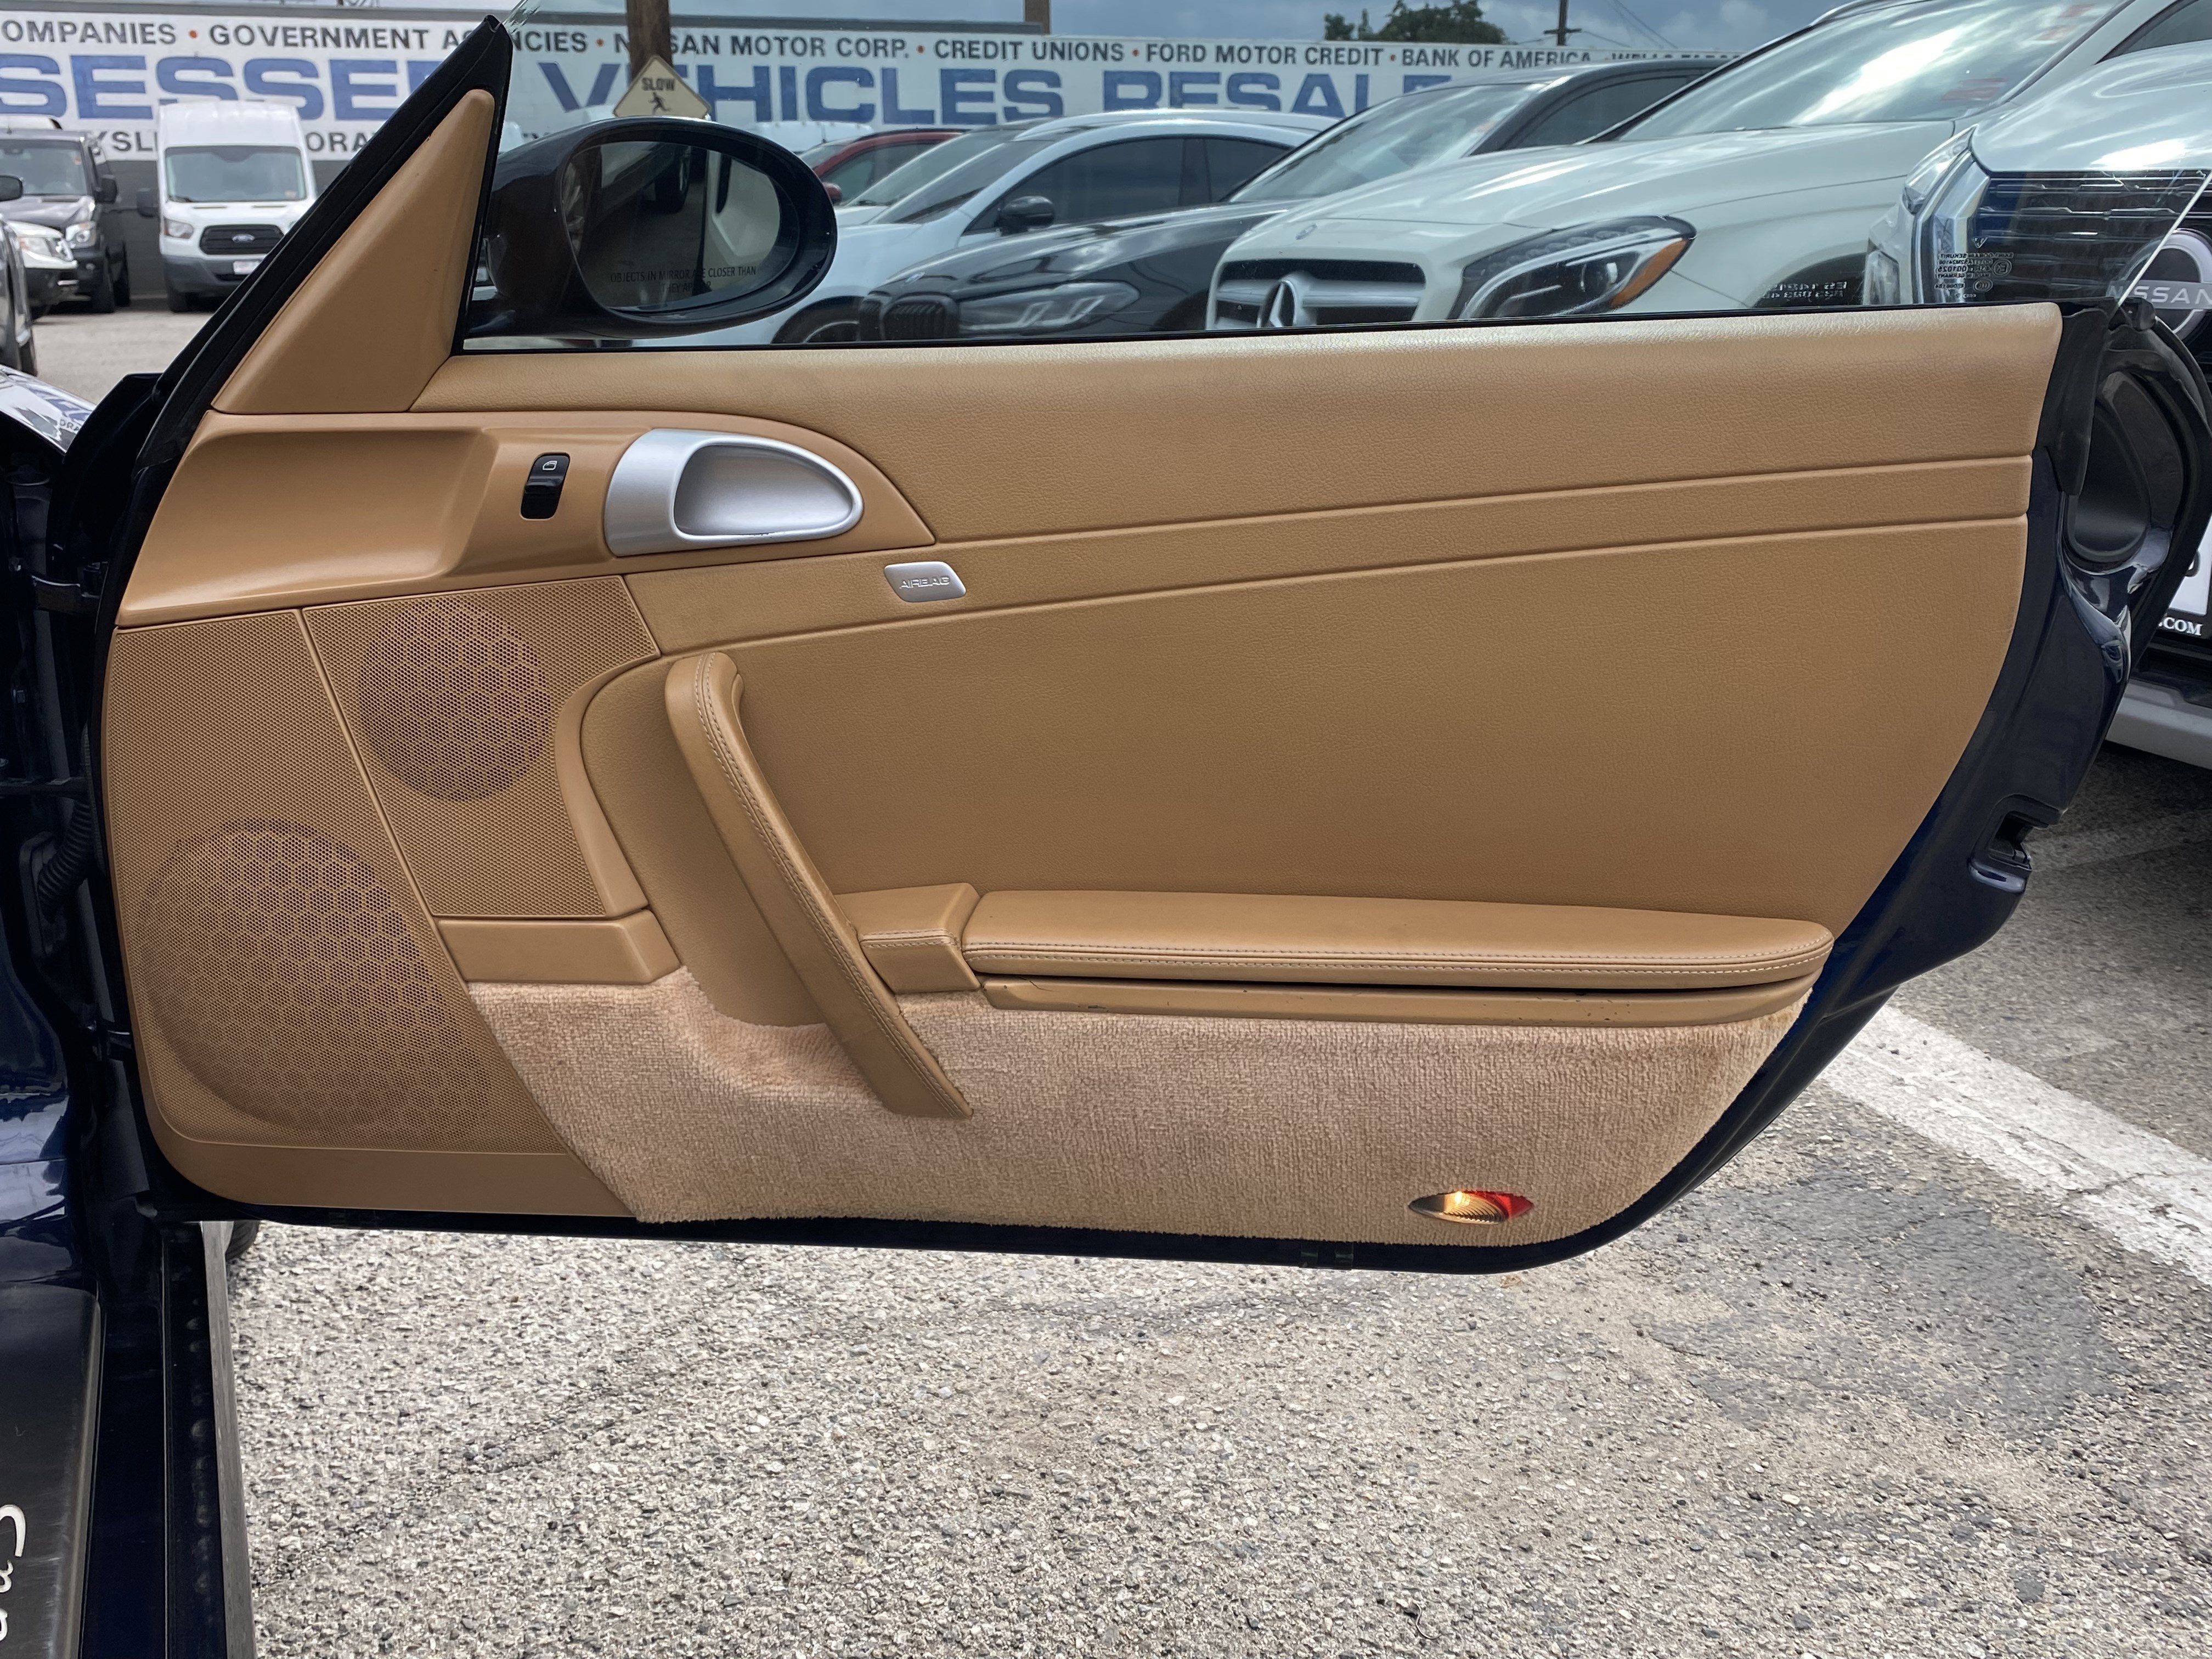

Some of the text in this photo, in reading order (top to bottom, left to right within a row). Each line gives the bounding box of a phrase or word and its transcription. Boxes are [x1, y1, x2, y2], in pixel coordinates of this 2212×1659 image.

[210, 25, 428, 49] GOVERNMENT
[731, 36, 825, 57] MOTOR
[837, 37, 909, 58] CORP.
[935, 39, 1023, 59] CREDIT
[1032, 42, 1124, 61] UNIONS
[1147, 43, 1206, 63] FORD
[1216, 45, 1296, 64] MOTOR
[1305, 47, 1384, 65] CREDIT
[1402, 49, 1459, 66] BANK
[1468, 49, 1494, 67] OF
[641, 77, 676, 91] SLOW
[611, 270, 645, 283] OBJECTS
[648, 270, 656, 281] IN
[659, 269, 690, 280] MIRROR
[708, 266, 736, 278] CLOSER
[738, 265, 757, 276] THAN
[899, 576, 951, 589] AIRBAG
